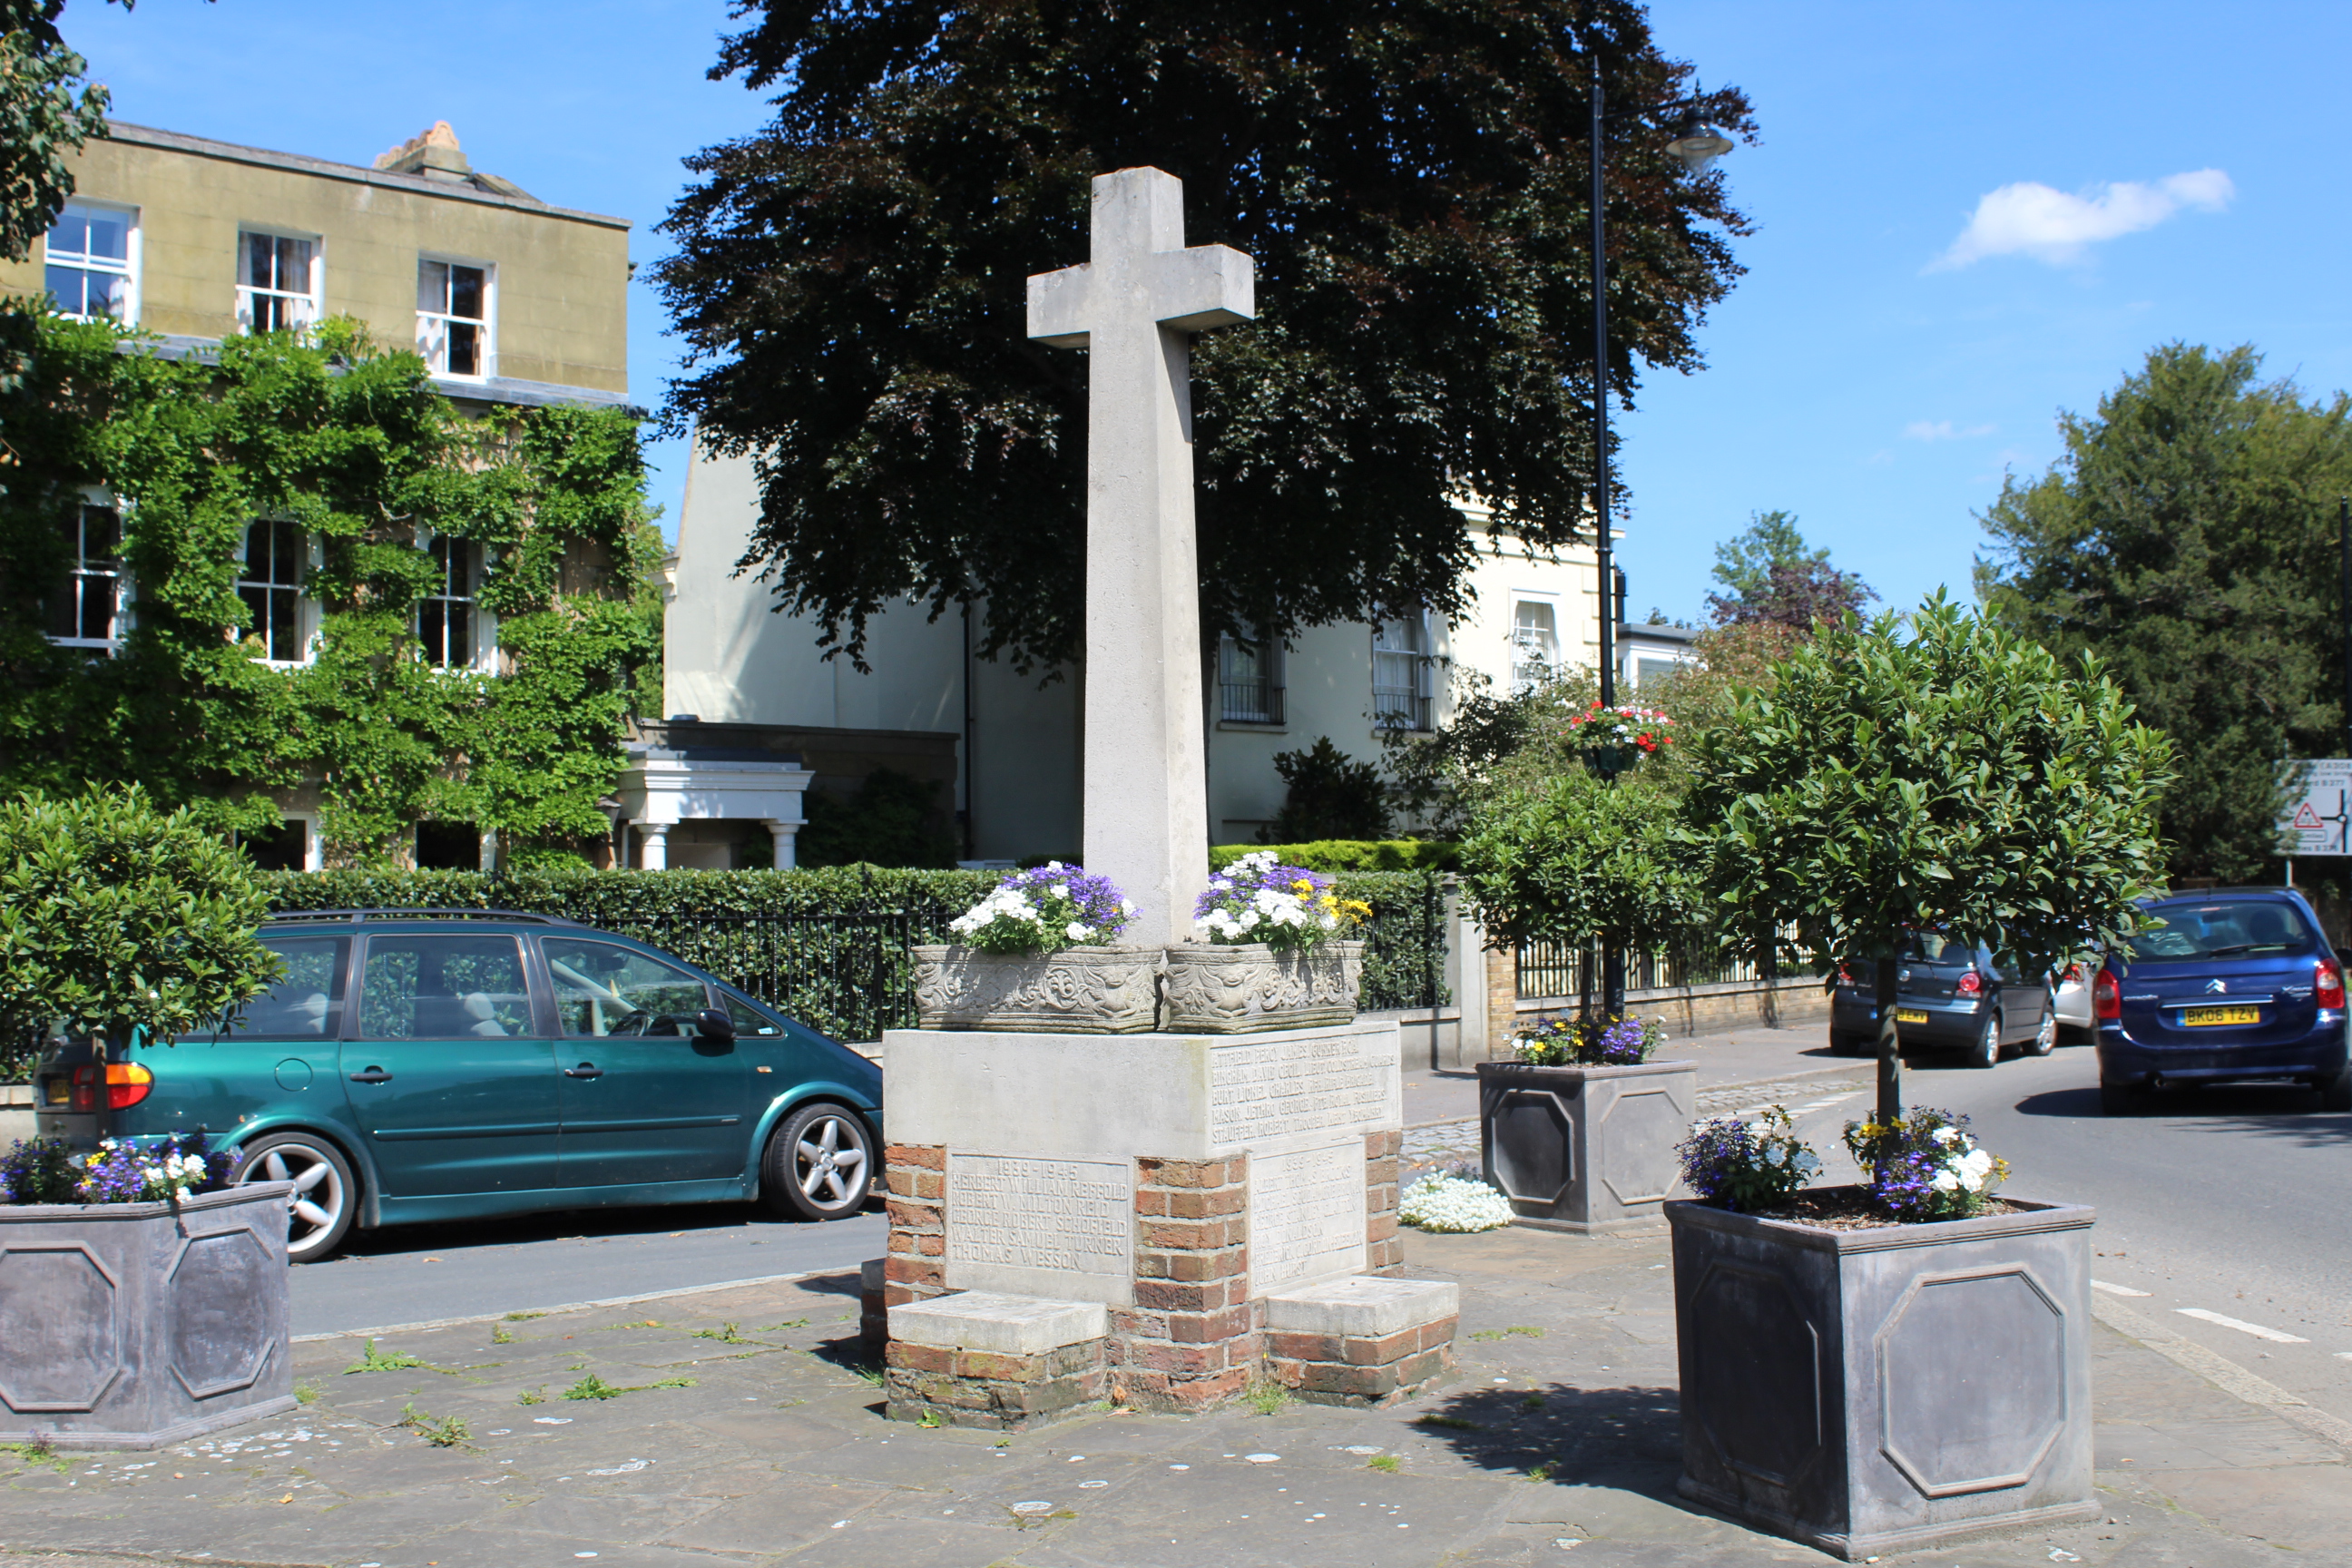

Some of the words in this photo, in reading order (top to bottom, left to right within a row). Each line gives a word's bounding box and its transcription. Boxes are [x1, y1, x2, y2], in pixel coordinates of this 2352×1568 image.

[2187, 1008, 2223, 1024] BK06
[2230, 1006, 2256, 1022] TZV
[952, 1173, 1006, 1191] HERBERT
[1008, 1177, 1070, 1197] WILLIAM
[1071, 1181, 1128, 1201] REFFOLD
[952, 1191, 998, 1210] ROBERT
[1019, 1195, 1073, 1215] MILTON
[1077, 1199, 1110, 1218] REID
[952, 1208, 998, 1226] GEORGE
[1003, 1211, 1052, 1230] ROBERT
[1056, 1216, 1127, 1238] SCHOFIELD
[952, 1225, 1006, 1245] WALTER
[1008, 1230, 1061, 1250] SAMUEL
[1064, 1235, 1124, 1256] TURNER
[953, 1243, 1013, 1264] THOMAS
[1021, 1248, 1082, 1269] WESSON
